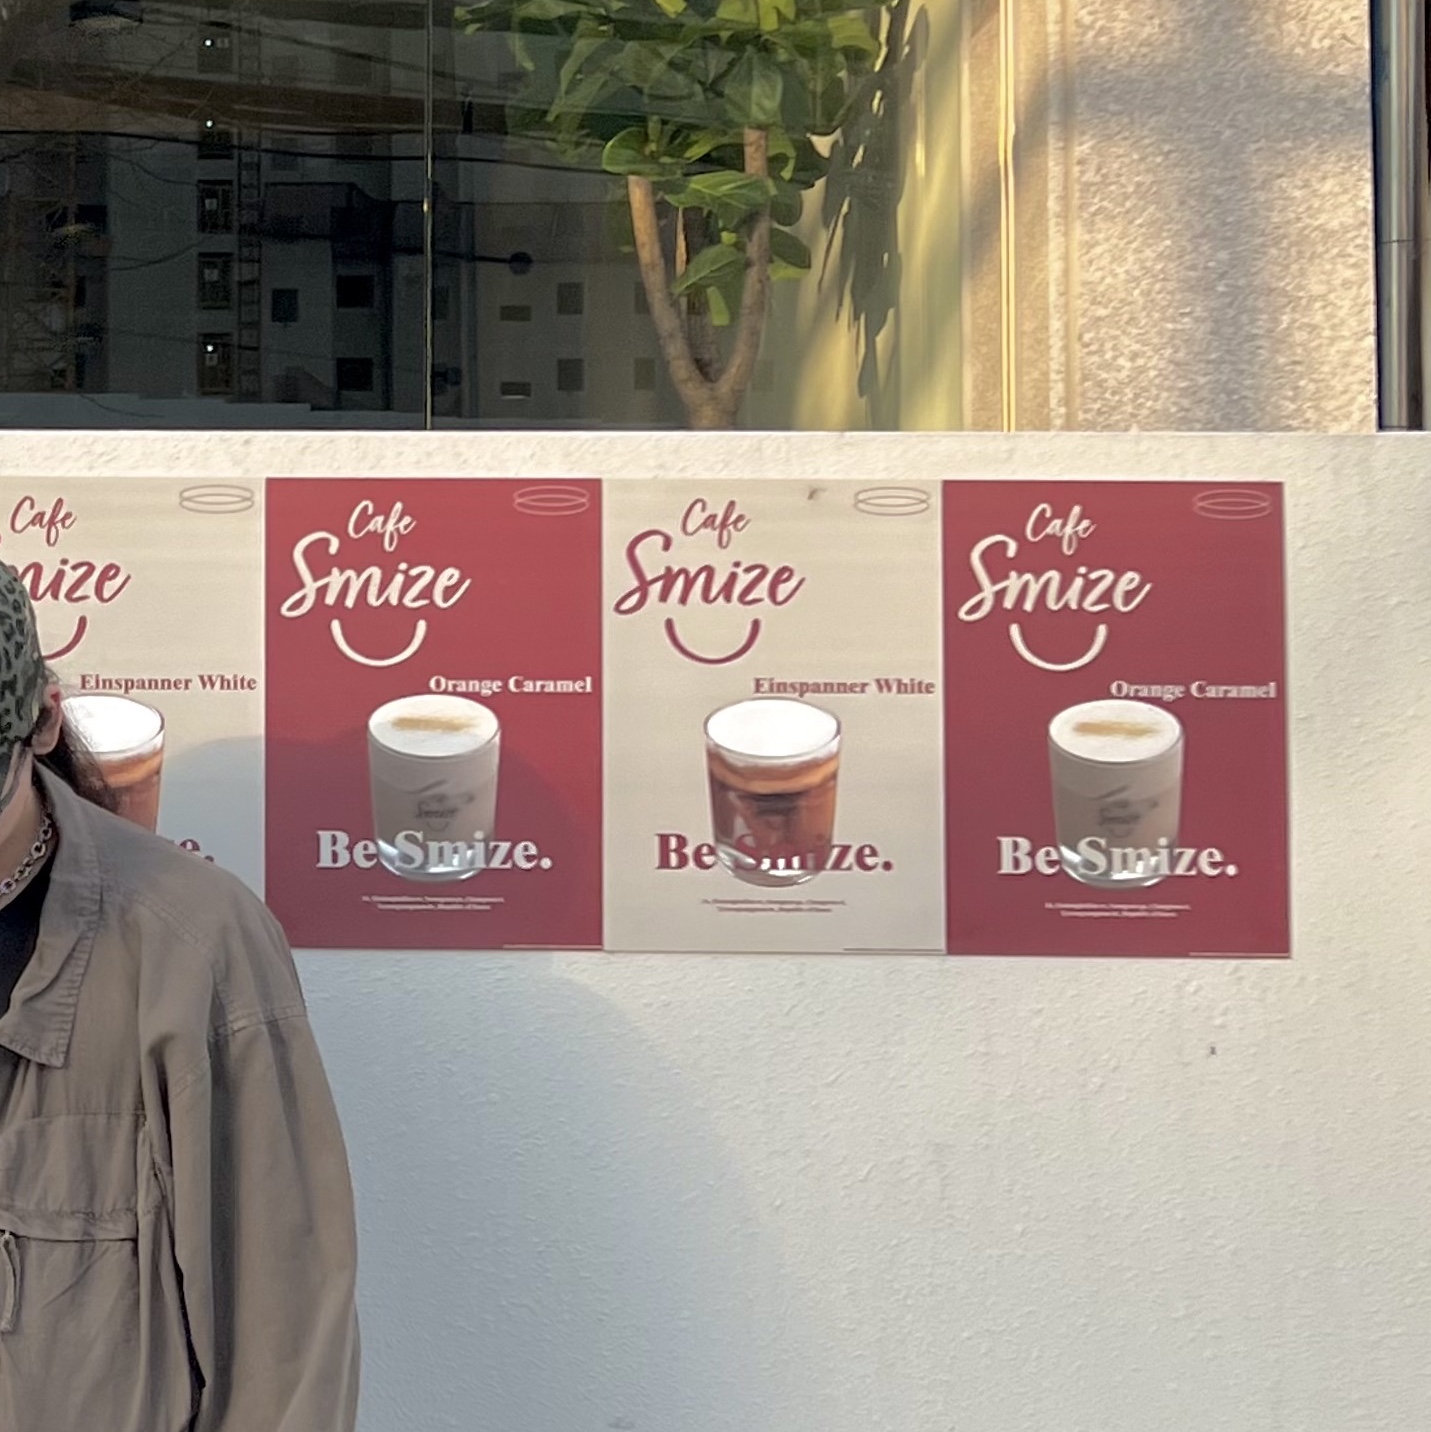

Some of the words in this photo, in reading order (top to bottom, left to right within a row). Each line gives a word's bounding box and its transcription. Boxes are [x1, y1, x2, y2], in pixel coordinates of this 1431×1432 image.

[9, 495, 77, 547] Cafe
[347, 500, 416, 552] Cafe
[681, 498, 750, 550] Cafe
[1025, 503, 1095, 556] Cafe
[281, 532, 471, 617] Smize
[614, 529, 805, 615] Smize
[958, 534, 1152, 621] Smize
[79, 673, 193, 695] Einspanner
[198, 674, 257, 691] White
[429, 676, 503, 696] Orange
[508, 676, 592, 693] Caramel
[753, 677, 870, 699] Einspanner
[874, 677, 935, 695] White
[1111, 680, 1184, 700] Orange
[1189, 680, 1277, 698] Caramel
[316, 830, 378, 869] Be
[395, 830, 552, 870] Smize.
[655, 833, 716, 871] Be
[997, 836, 1061, 875] Be
[1076, 836, 1238, 876] Smize.
